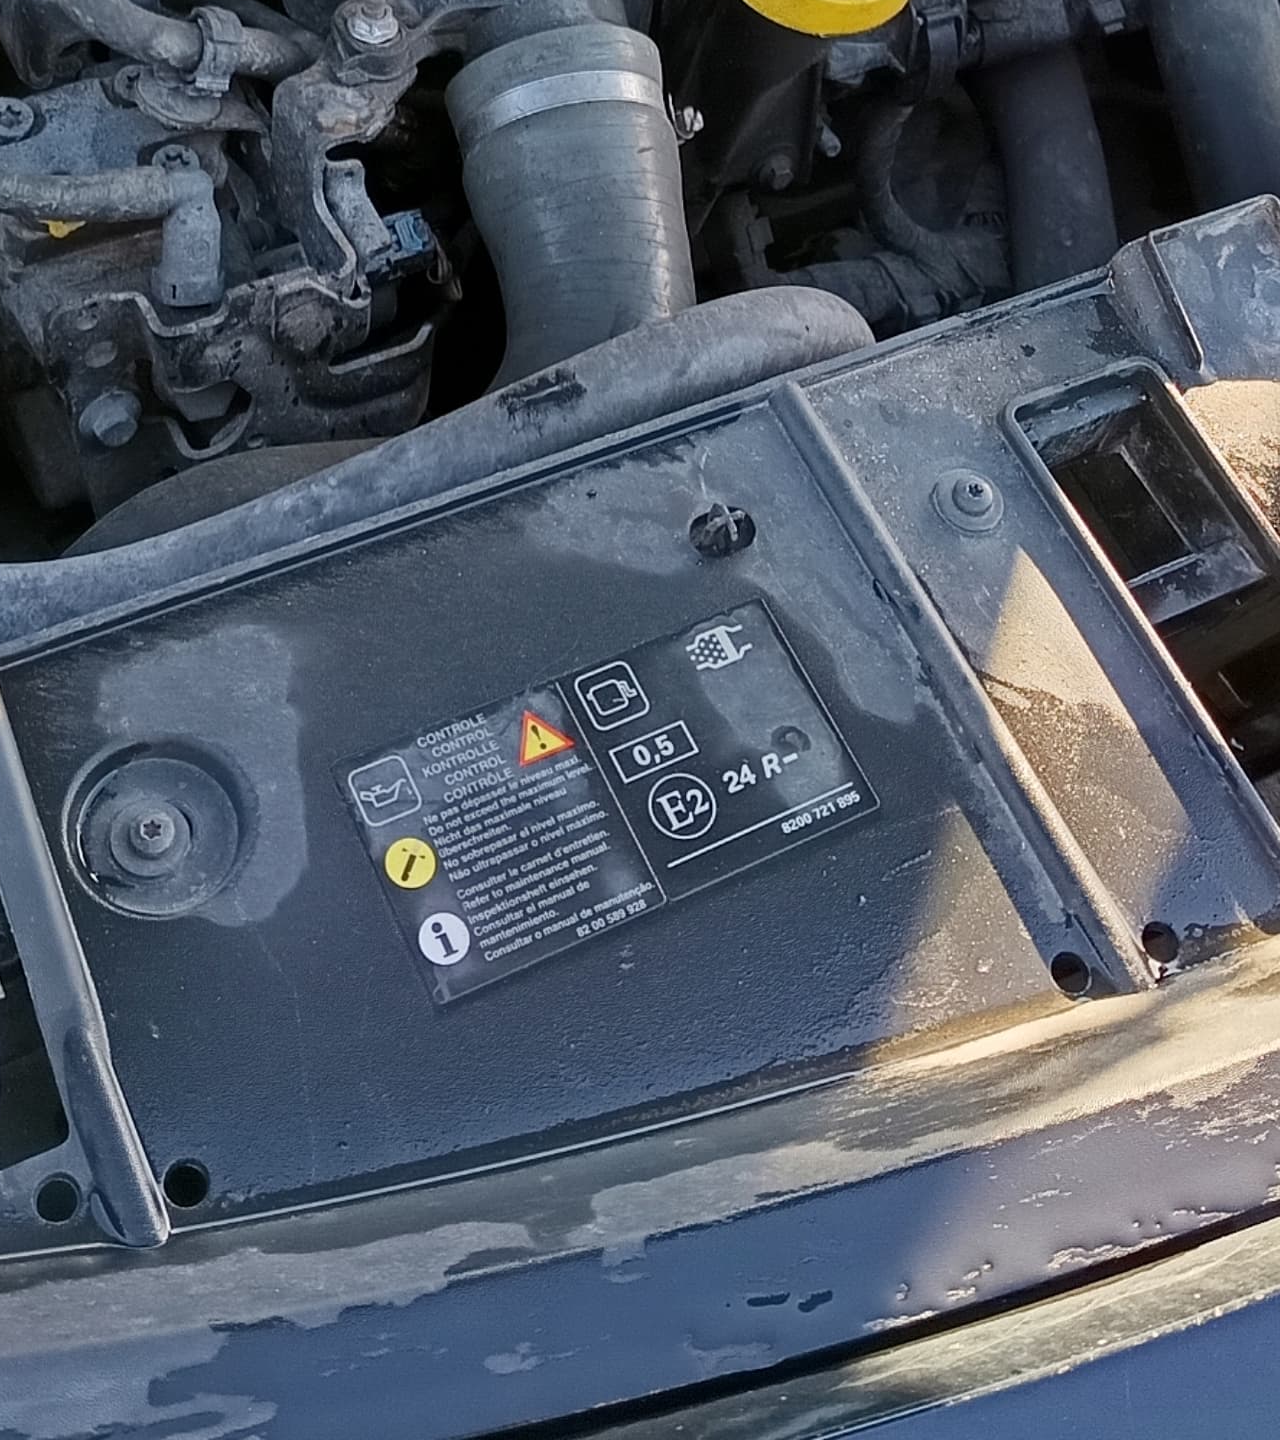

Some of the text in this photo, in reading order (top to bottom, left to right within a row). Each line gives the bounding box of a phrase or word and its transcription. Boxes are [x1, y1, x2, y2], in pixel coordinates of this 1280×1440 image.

[417, 713, 487, 748] CONTROLE
[431, 727, 494, 757] CONTROL
[632, 734, 674, 765] 0,5
[421, 739, 499, 778] KONTROLLE
[444, 753, 507, 785] CONTROL
[722, 763, 756, 793] 24
[422, 755, 583, 825] Ne pas dépasser le niveau maxi.
[427, 763, 592, 836] Do not exceed the maximum level.
[443, 766, 515, 803] CONTRÔLE
[433, 786, 567, 847] Nicht das maximale niveau
[655, 788, 710, 832] E2
[781, 790, 859, 833] 8200 721 895
[442, 858, 459, 869] No
[460, 833, 516, 862] sobrepasar
[519, 826, 529, 837] el
[530, 815, 555, 832] nivel
[448, 868, 470, 881] Não
[471, 842, 528, 872] ultrapassar
[456, 830, 609, 899] Consulter le carnet d'entretien.
[462, 841, 611, 911] Refer to maintenance manual.
[466, 864, 597, 924] Inspektionsheft einsehen.
[473, 881, 589, 936] Consultar el manual de
[479, 909, 559, 948] mantenimiento.
[484, 881, 655, 961] Consultar o manual de manutenção.
[576, 924, 590, 936] 82
[590, 917, 605, 929] 00
[626, 899, 646, 914] 928
